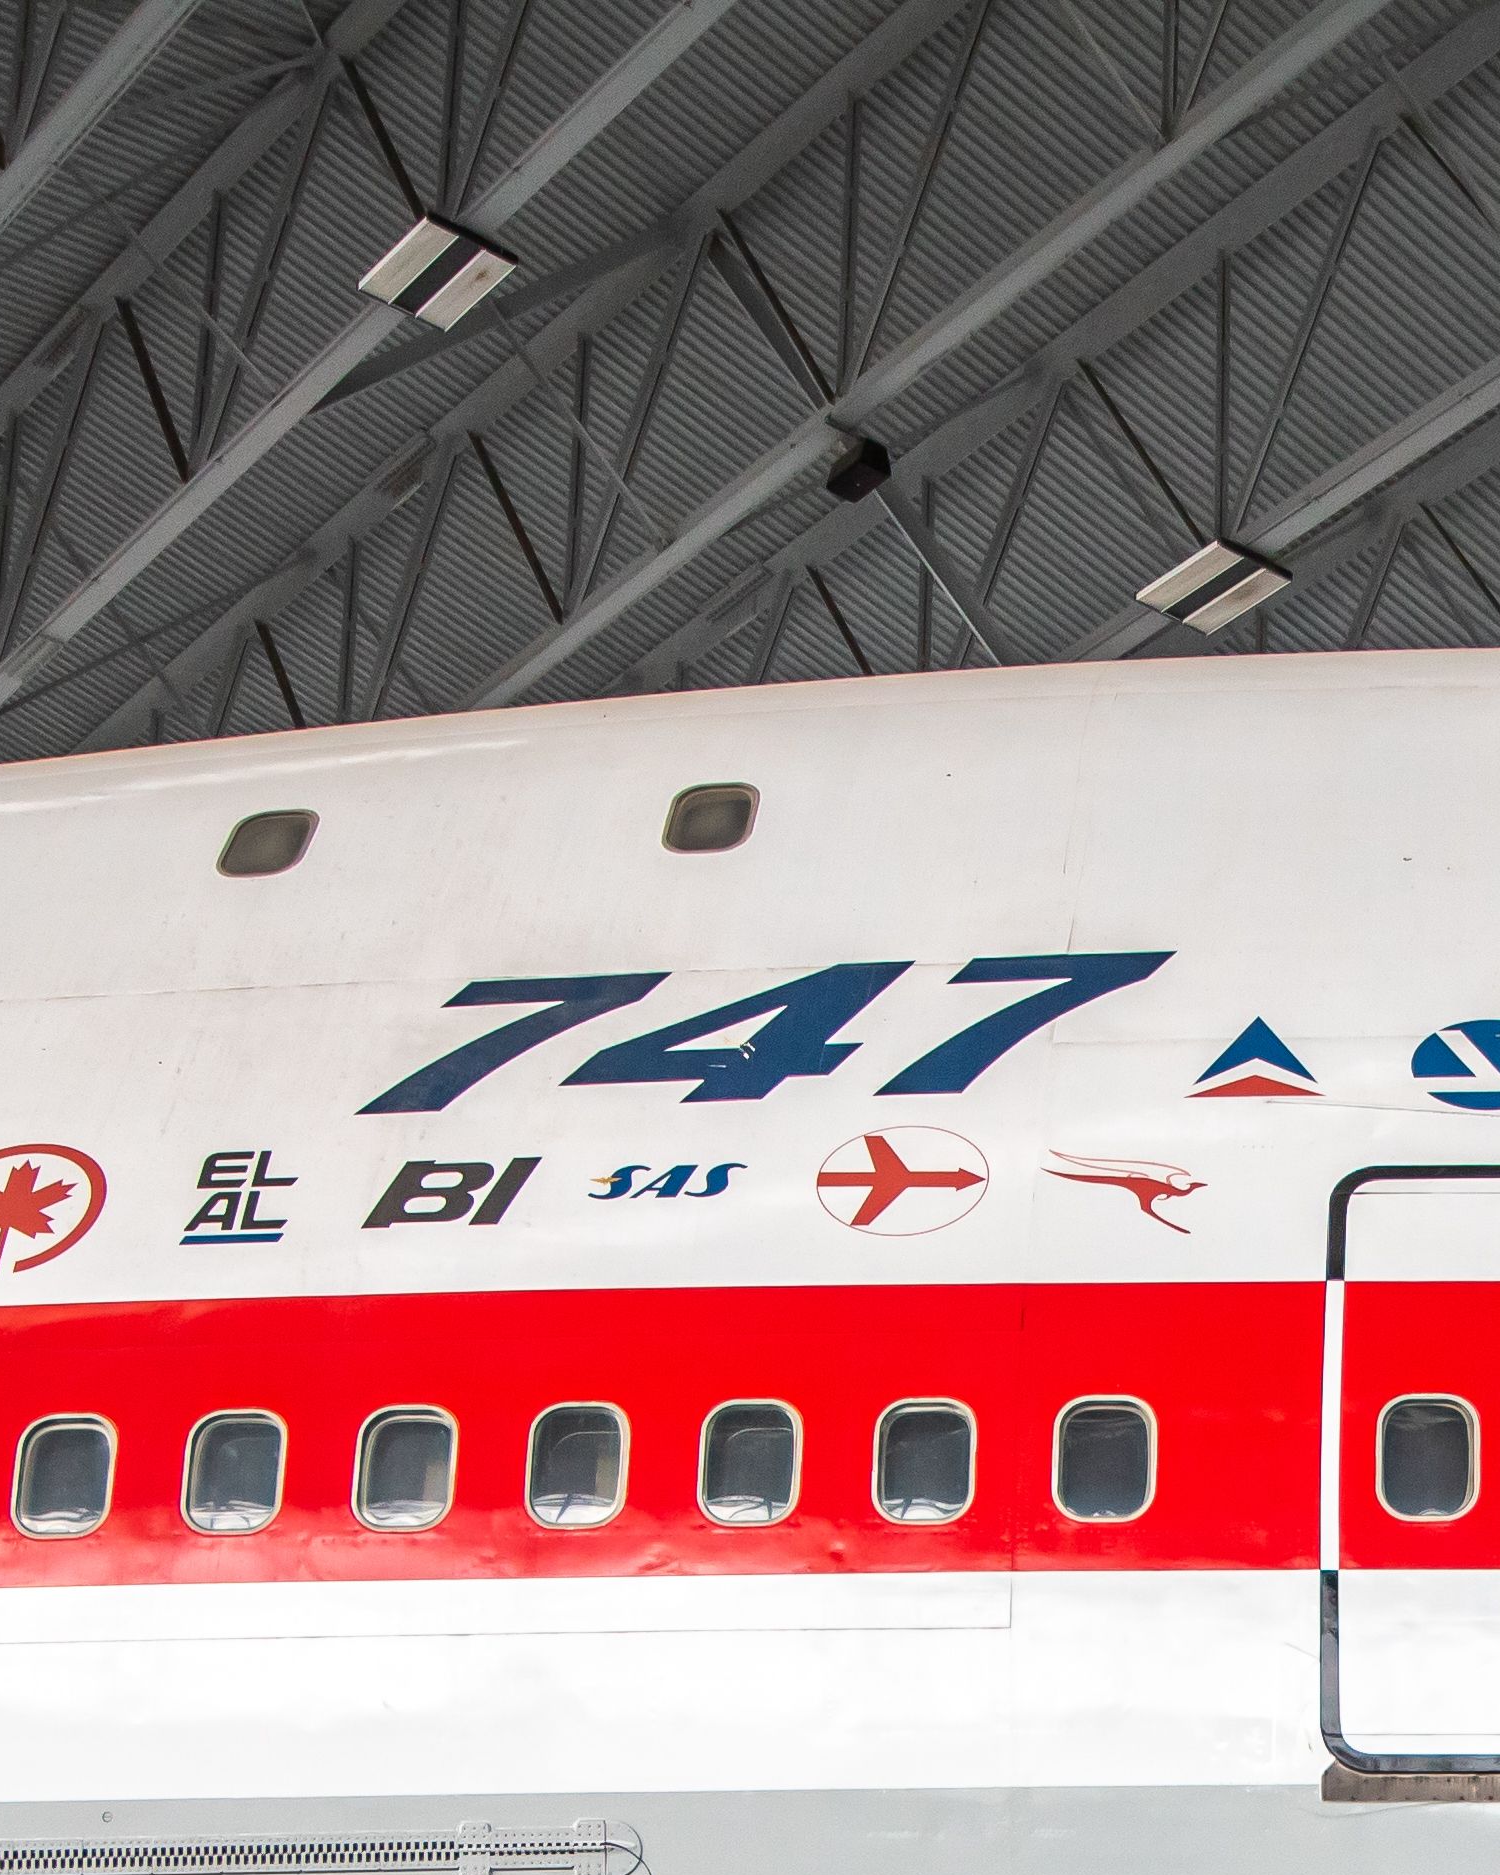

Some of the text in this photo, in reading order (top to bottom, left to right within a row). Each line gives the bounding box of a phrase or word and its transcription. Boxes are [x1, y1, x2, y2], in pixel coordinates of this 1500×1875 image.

[354, 950, 1178, 1115] 747
[196, 1150, 299, 1187] EL
[588, 1162, 748, 1200] SAS
[184, 1190, 289, 1231] AL
[360, 1155, 543, 1230] BI
